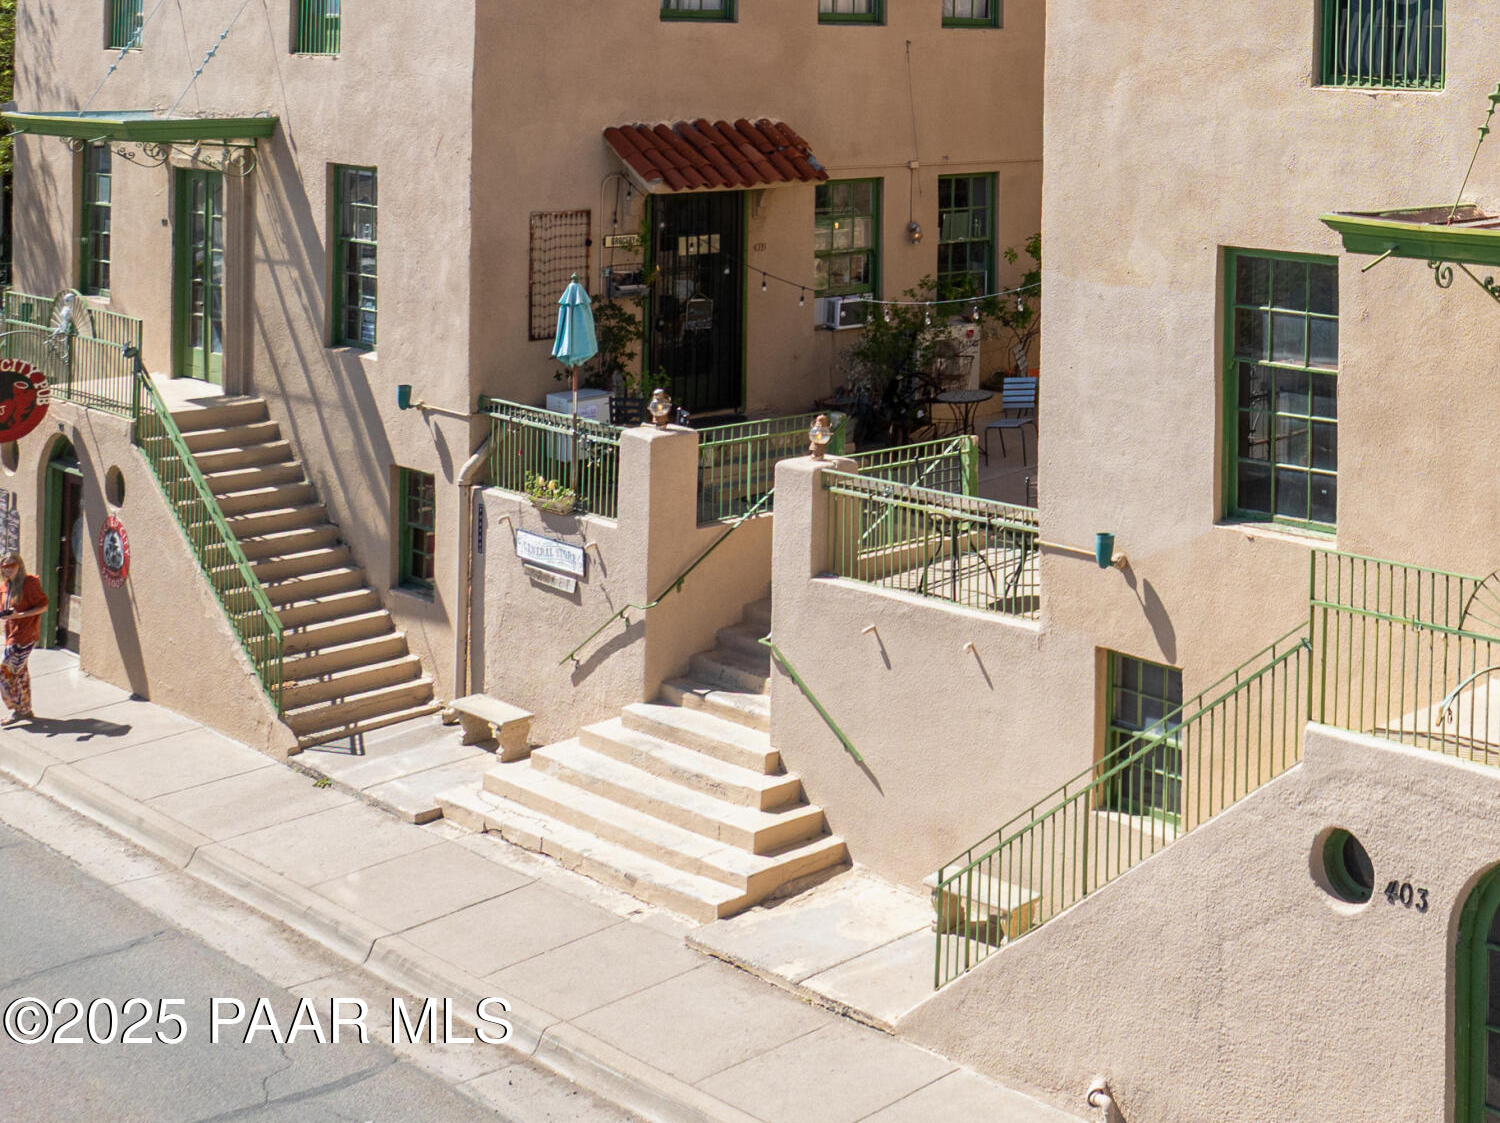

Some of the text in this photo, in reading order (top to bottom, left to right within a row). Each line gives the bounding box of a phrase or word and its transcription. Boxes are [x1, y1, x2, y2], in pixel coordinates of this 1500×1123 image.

[0, 358, 51, 406] CITY PUB
[1384, 880, 1429, 913] 403
